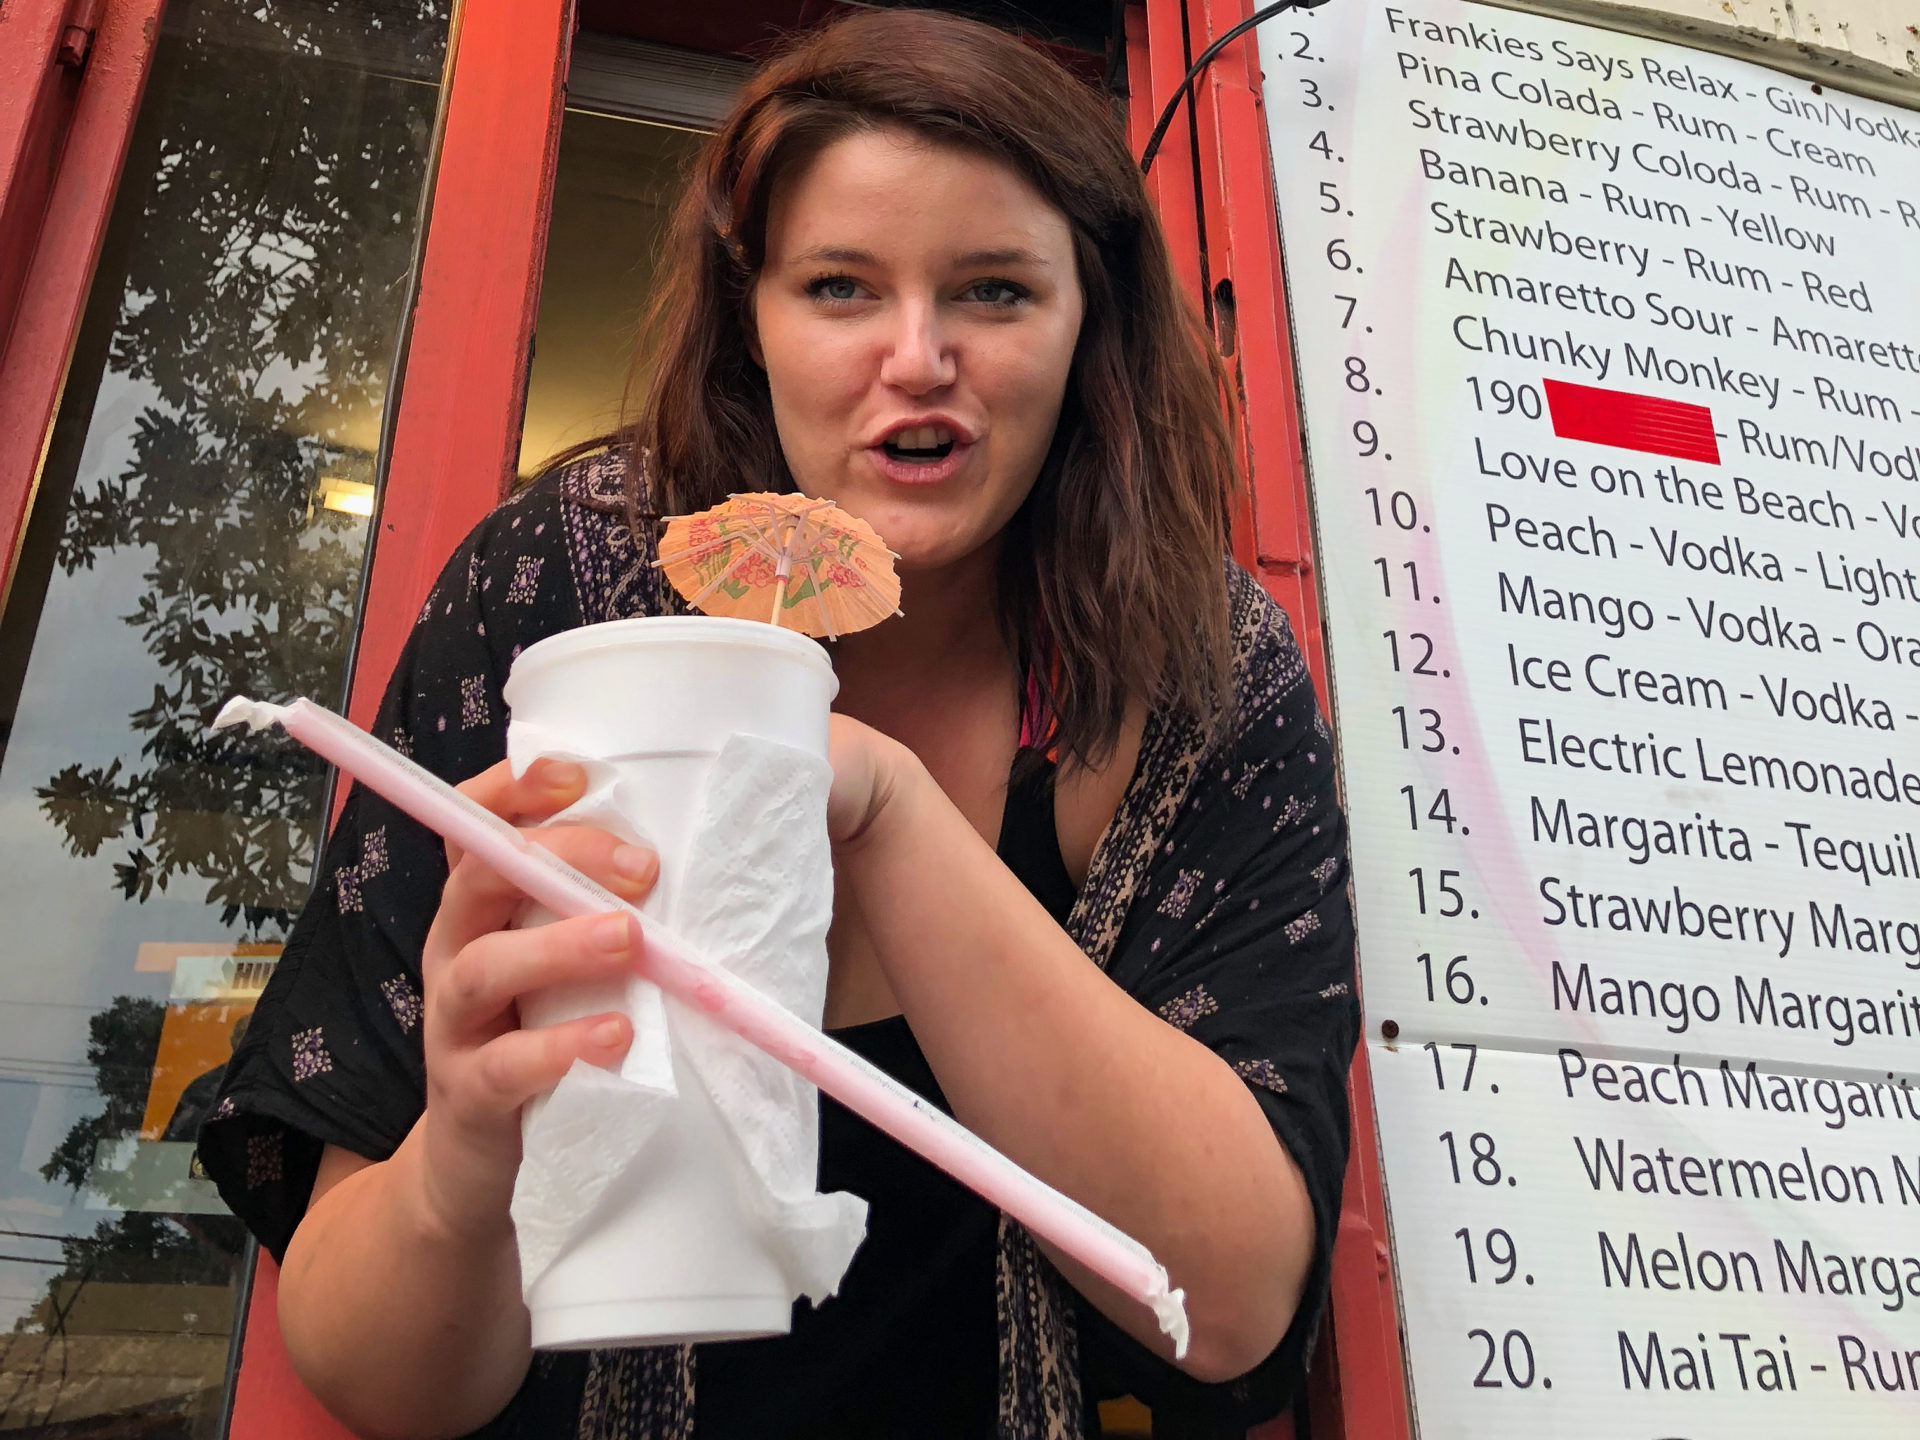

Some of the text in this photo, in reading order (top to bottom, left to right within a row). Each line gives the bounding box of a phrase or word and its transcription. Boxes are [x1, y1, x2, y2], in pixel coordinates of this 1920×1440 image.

[1385, 7, 1544, 62] Frankies
[1551, 40, 1634, 82] Says
[1640, 57, 1739, 102] Relax
[1299, 78, 1335, 112] 3.
[1408, 99, 1620, 173] Strawberry
[1632, 143, 1762, 195] Coloda
[1789, 175, 1871, 219] Rum
[1397, 51, 1481, 93] Pina
[1491, 71, 1623, 121] Colada
[1652, 102, 1737, 145] Rum
[1766, 127, 1876, 177] Cream
[1308, 130, 1345, 163] 4.
[1419, 148, 1569, 204] Banana
[1601, 182, 1691, 228] Rum
[1716, 205, 1835, 257] Yellow
[1319, 181, 1354, 217] 5.
[1430, 201, 1649, 278] Strawberry
[1683, 247, 1772, 294] Rum
[1801, 271, 1873, 313] Red
[1326, 238, 1364, 274] 6.
[1445, 257, 1636, 320] Amaretto
[1645, 292, 1734, 338] Sour
[1773, 315, 1920, 374] Amarett
[1334, 294, 1373, 334] 7.
[1452, 315, 1611, 381] Chunky
[1624, 342, 1780, 410] Monkey
[1813, 376, 1902, 423] Rum
[1344, 356, 1383, 396] 8.
[1466, 376, 1542, 420] 190
[1737, 418, 1920, 482] Rum/Vod
[1352, 420, 1392, 461] 9.
[1474, 436, 1578, 488] Love
[1590, 465, 1645, 499] on
[1654, 465, 1724, 511] the
[1733, 477, 1855, 531] Beach
[1364, 487, 1431, 534] 10.
[1485, 502, 1618, 559] Peach
[1649, 526, 1784, 583] Vodka
[1816, 551, 1920, 607] Light
[1374, 557, 1441, 605] 11.
[1498, 571, 1654, 639] Mango
[1686, 596, 1822, 654] Vodka
[1382, 629, 1451, 679] 12.
[1507, 643, 1572, 692] Ice
[1584, 653, 1728, 711] Cream
[1759, 674, 1896, 731] Vodka
[1391, 705, 1920, 806] 13. Electric Lemonade
[1400, 784, 1470, 836] 14.
[1530, 795, 1753, 865] Margarita
[1408, 867, 1920, 971] 15. Strawberry Marg
[1416, 952, 1488, 1006] 16.
[1551, 960, 1720, 1034] Mango
[1423, 1041, 1499, 1094] 17.
[1557, 1047, 1709, 1107] Peach
[1439, 1131, 1517, 1188] 18.
[1573, 1136, 1884, 1205] Watermelon
[1454, 1227, 1535, 1286] 19.
[1597, 1231, 1764, 1293] Melon
[1467, 1328, 1553, 1390] 20.
[1617, 1330, 1716, 1391] Mai
[1718, 1333, 1798, 1392] Tai
